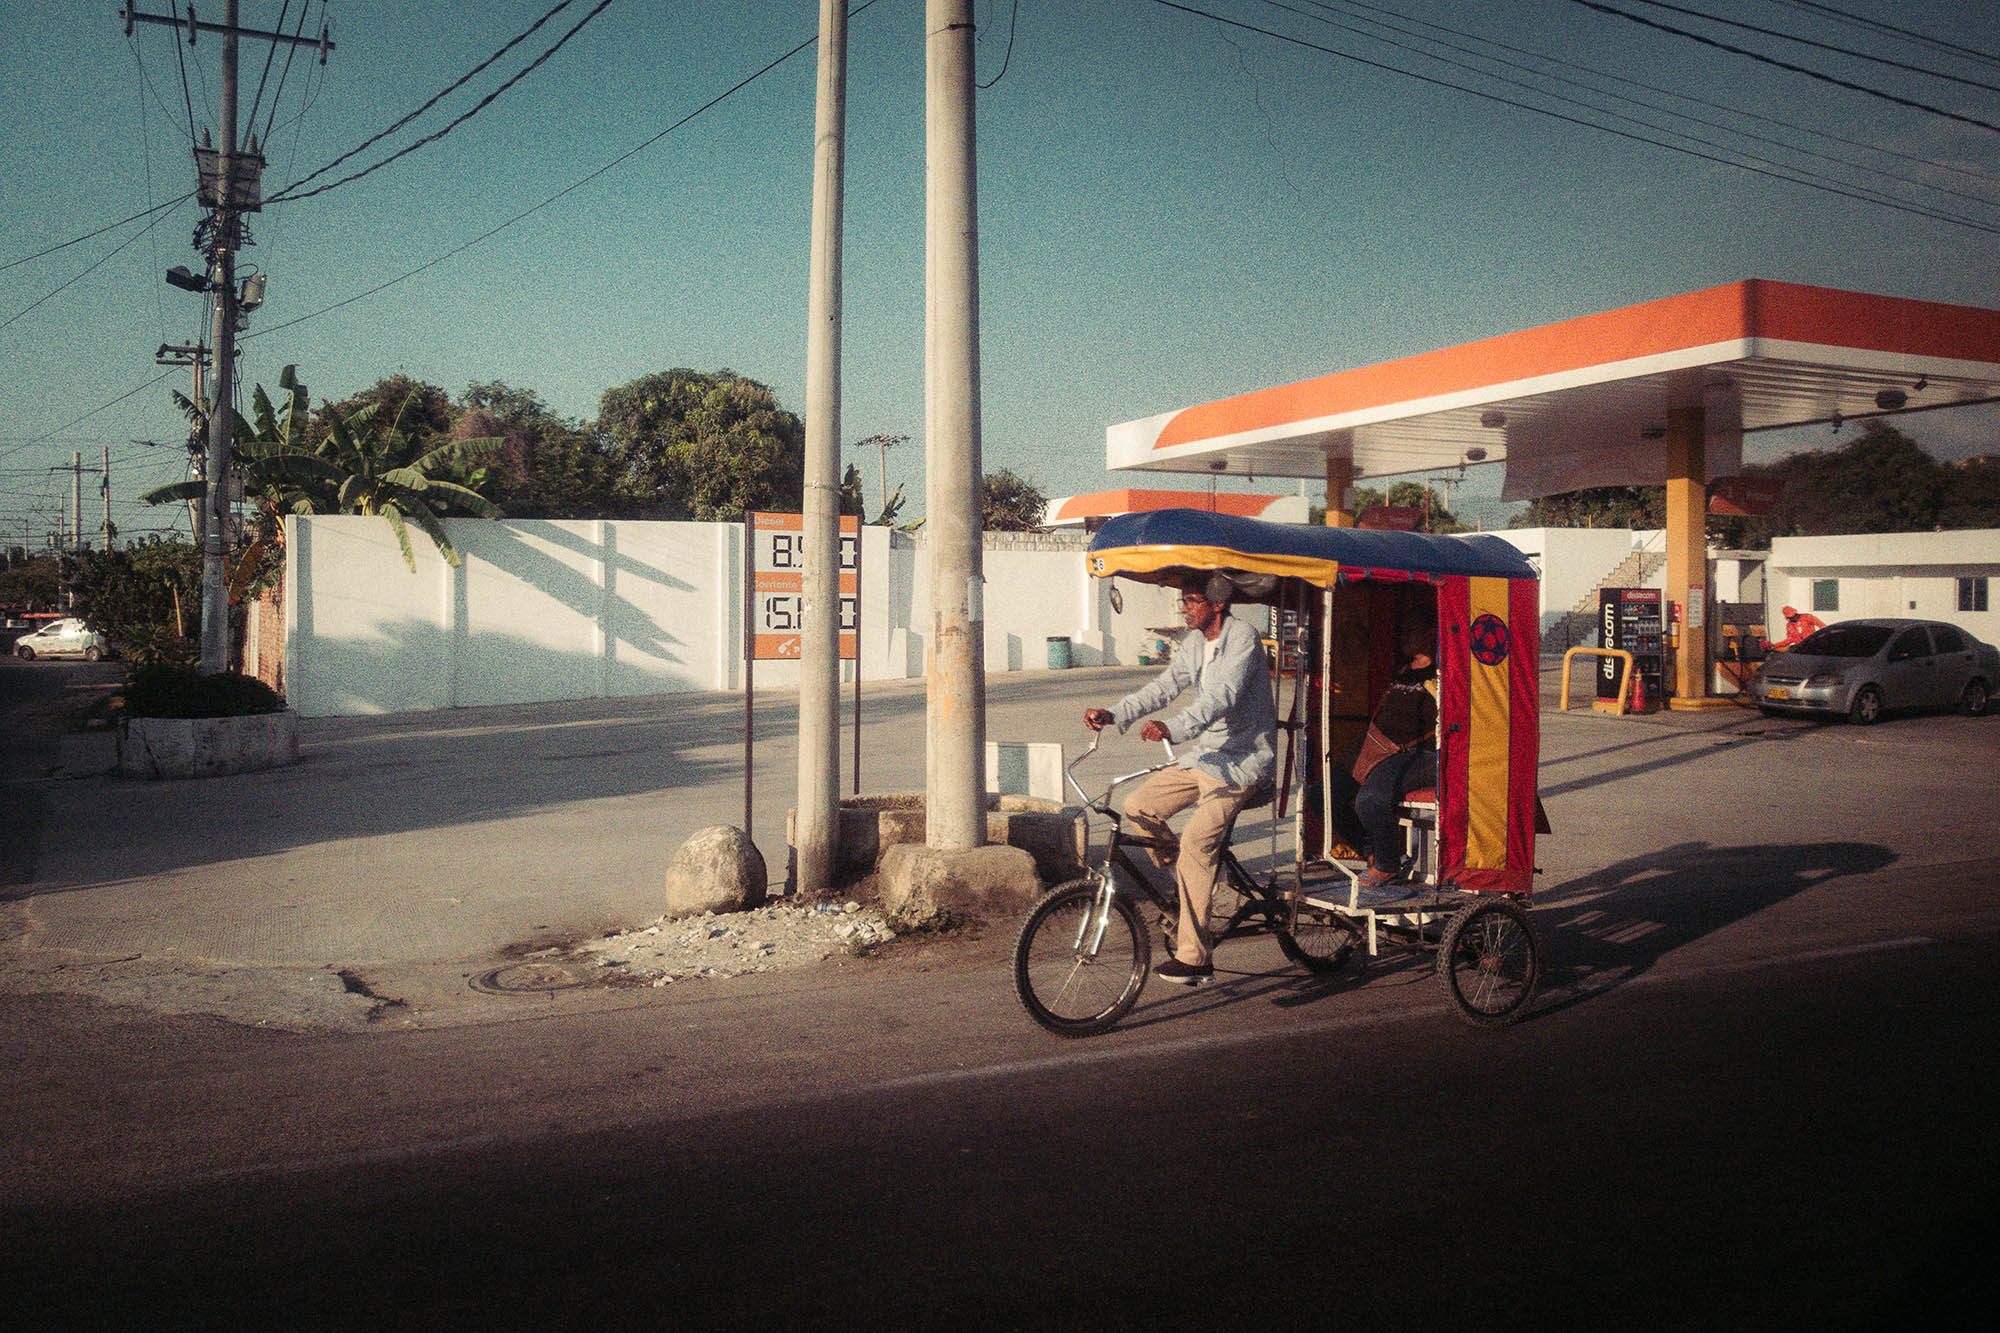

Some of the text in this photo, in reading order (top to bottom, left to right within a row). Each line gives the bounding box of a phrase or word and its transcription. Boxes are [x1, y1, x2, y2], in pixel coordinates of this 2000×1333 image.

[772, 535, 858, 569] 8.0
[766, 597, 858, 630] 15.0
[1602, 603, 1614, 680] disracom
